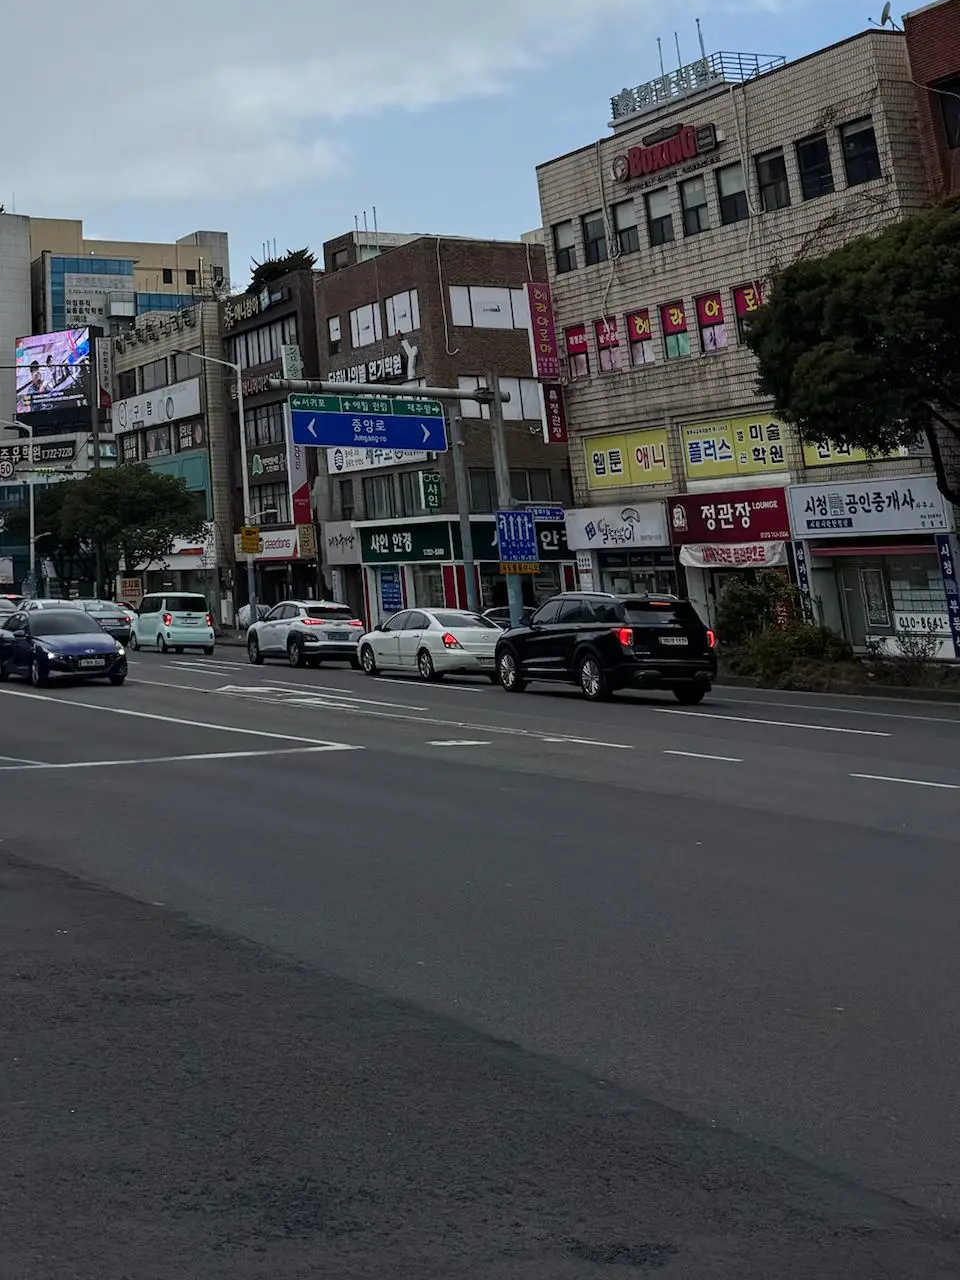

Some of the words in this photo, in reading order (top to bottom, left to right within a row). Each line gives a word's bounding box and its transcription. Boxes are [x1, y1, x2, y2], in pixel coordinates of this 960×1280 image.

[627, 125, 697, 179] BOXING
[302, 399, 326, 408] 서귀포
[352, 418, 387, 434] 중앙로
[749, 423, 781, 443] 미술
[593, 449, 623, 476] 웹툰
[635, 444, 667, 470] 애니
[688, 438, 734, 464] 플러스
[752, 445, 785, 465] 학원
[0, 464, 11, 474] 50
[427, 483, 439, 507] 사인
[804, 493, 828, 517] 시청
[845, 488, 916, 515] 공인중개사
[700, 502, 752, 530] 정관장
[752, 500, 779, 510] LOUNGE
[370, 533, 390, 553] 사인
[392, 532, 412, 553] 안경
[940, 544, 953, 576] 시청
